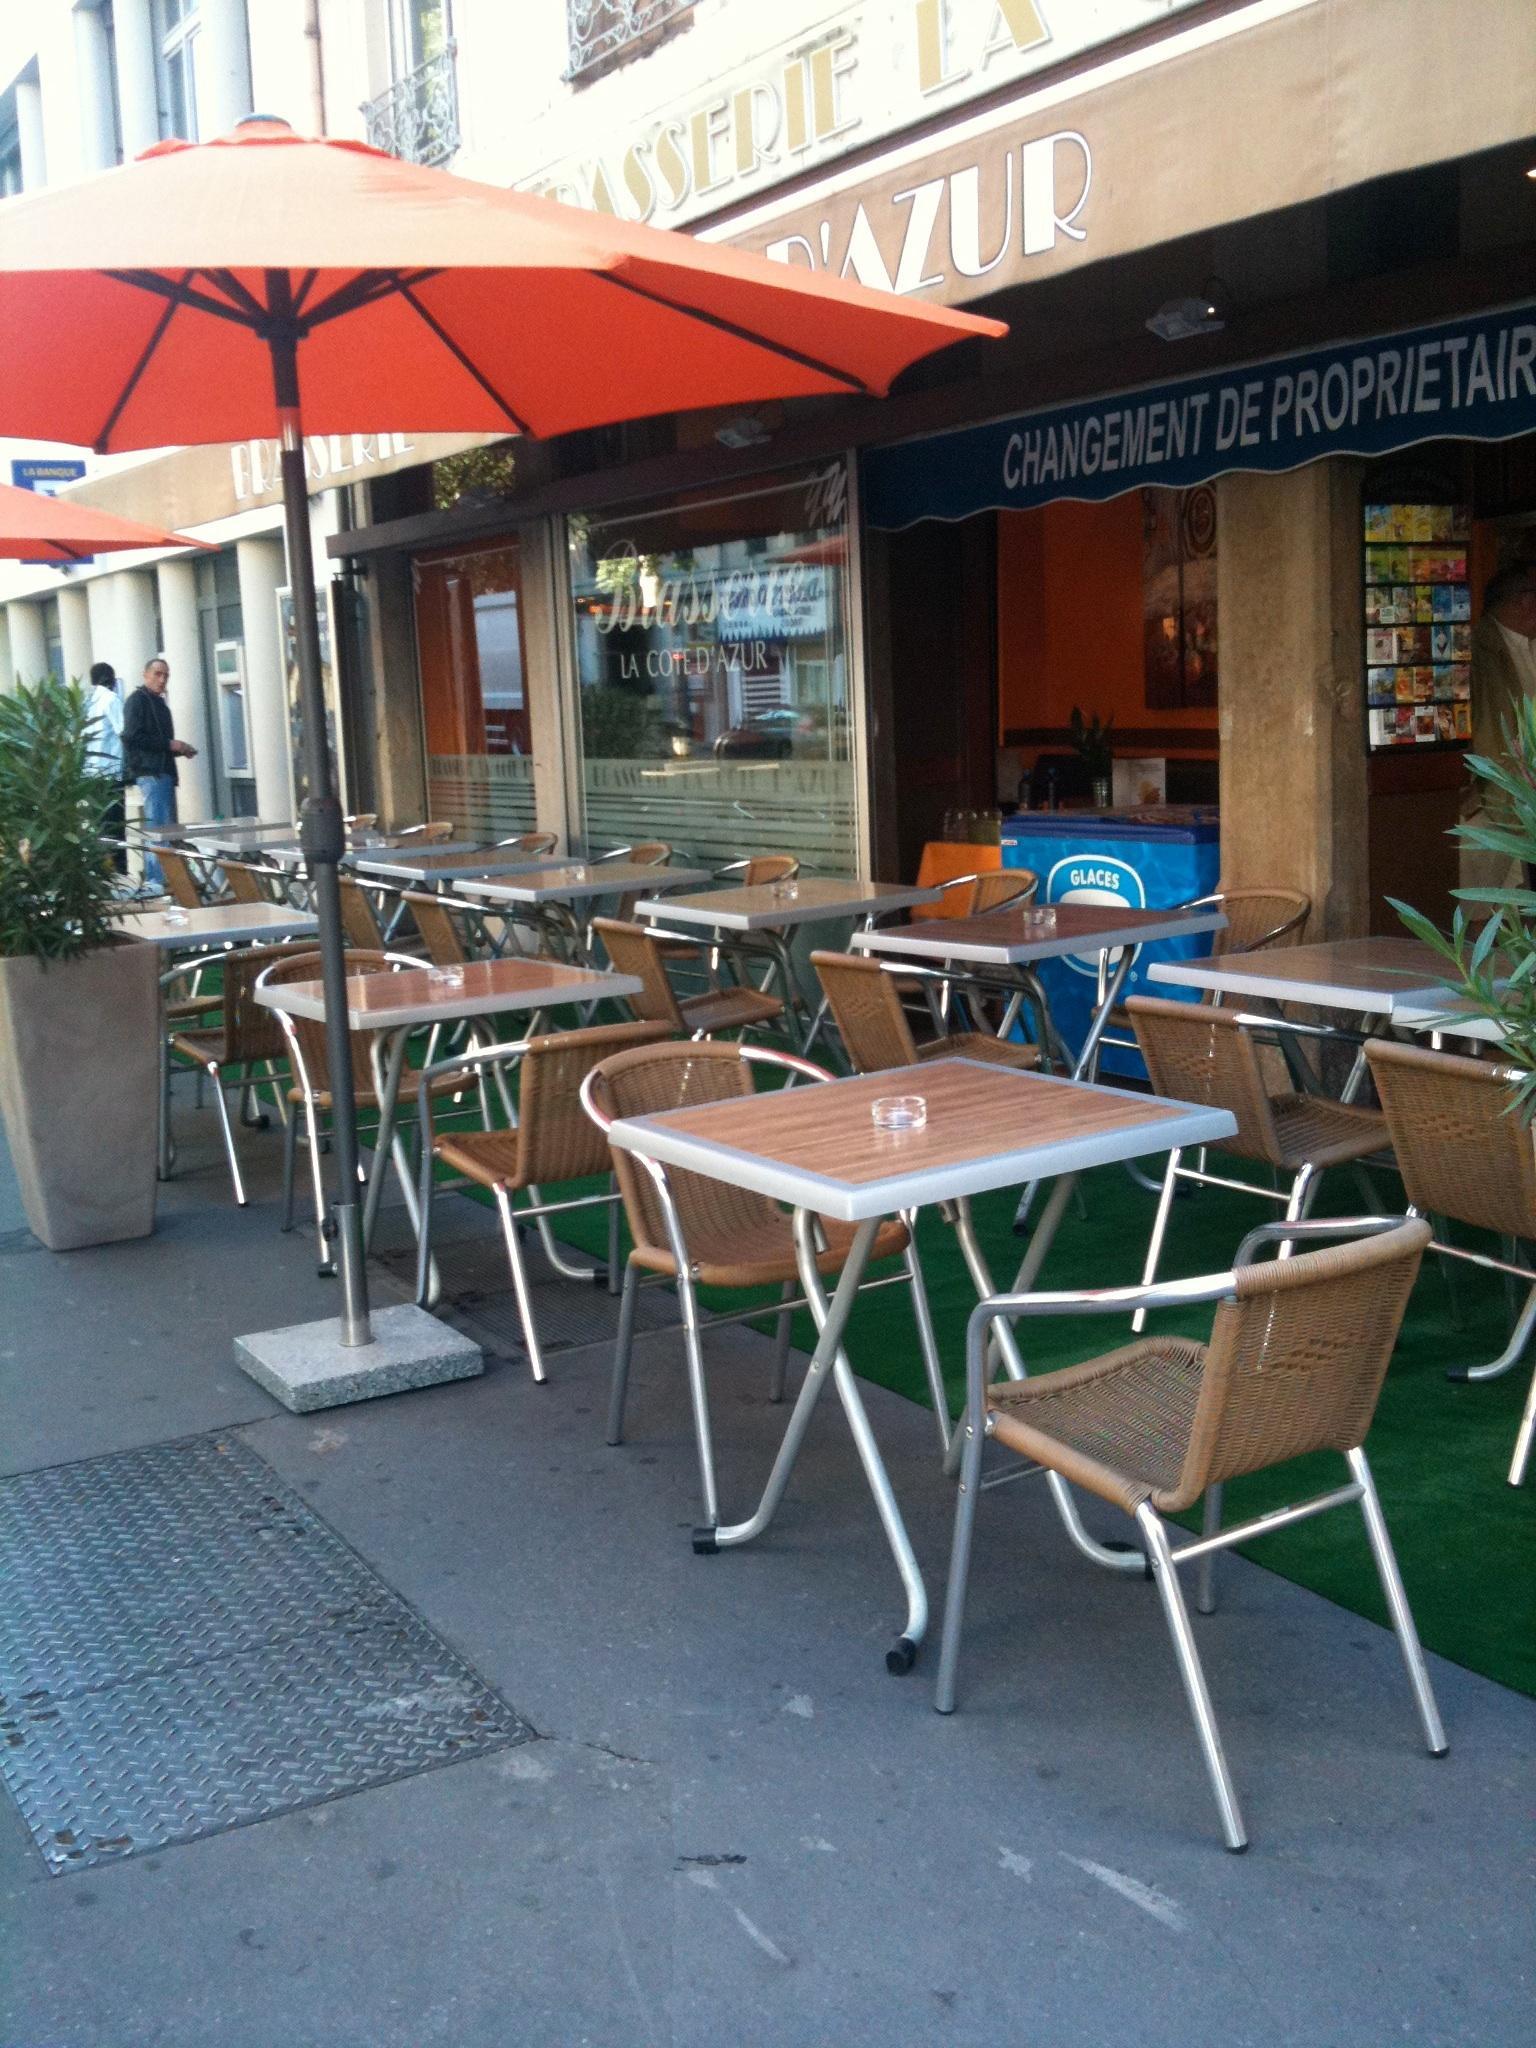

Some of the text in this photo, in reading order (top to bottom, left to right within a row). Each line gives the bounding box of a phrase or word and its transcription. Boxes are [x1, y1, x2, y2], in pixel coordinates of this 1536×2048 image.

[543, 0, 1053, 222] ASSERIE LA
[1002, 324, 1536, 488] CHANGEMENT DE PROPRIETAIR
[620, 653, 639, 679] LA
[696, 640, 768, 674] D'AZUR
[1070, 868, 1120, 890] GLACES
